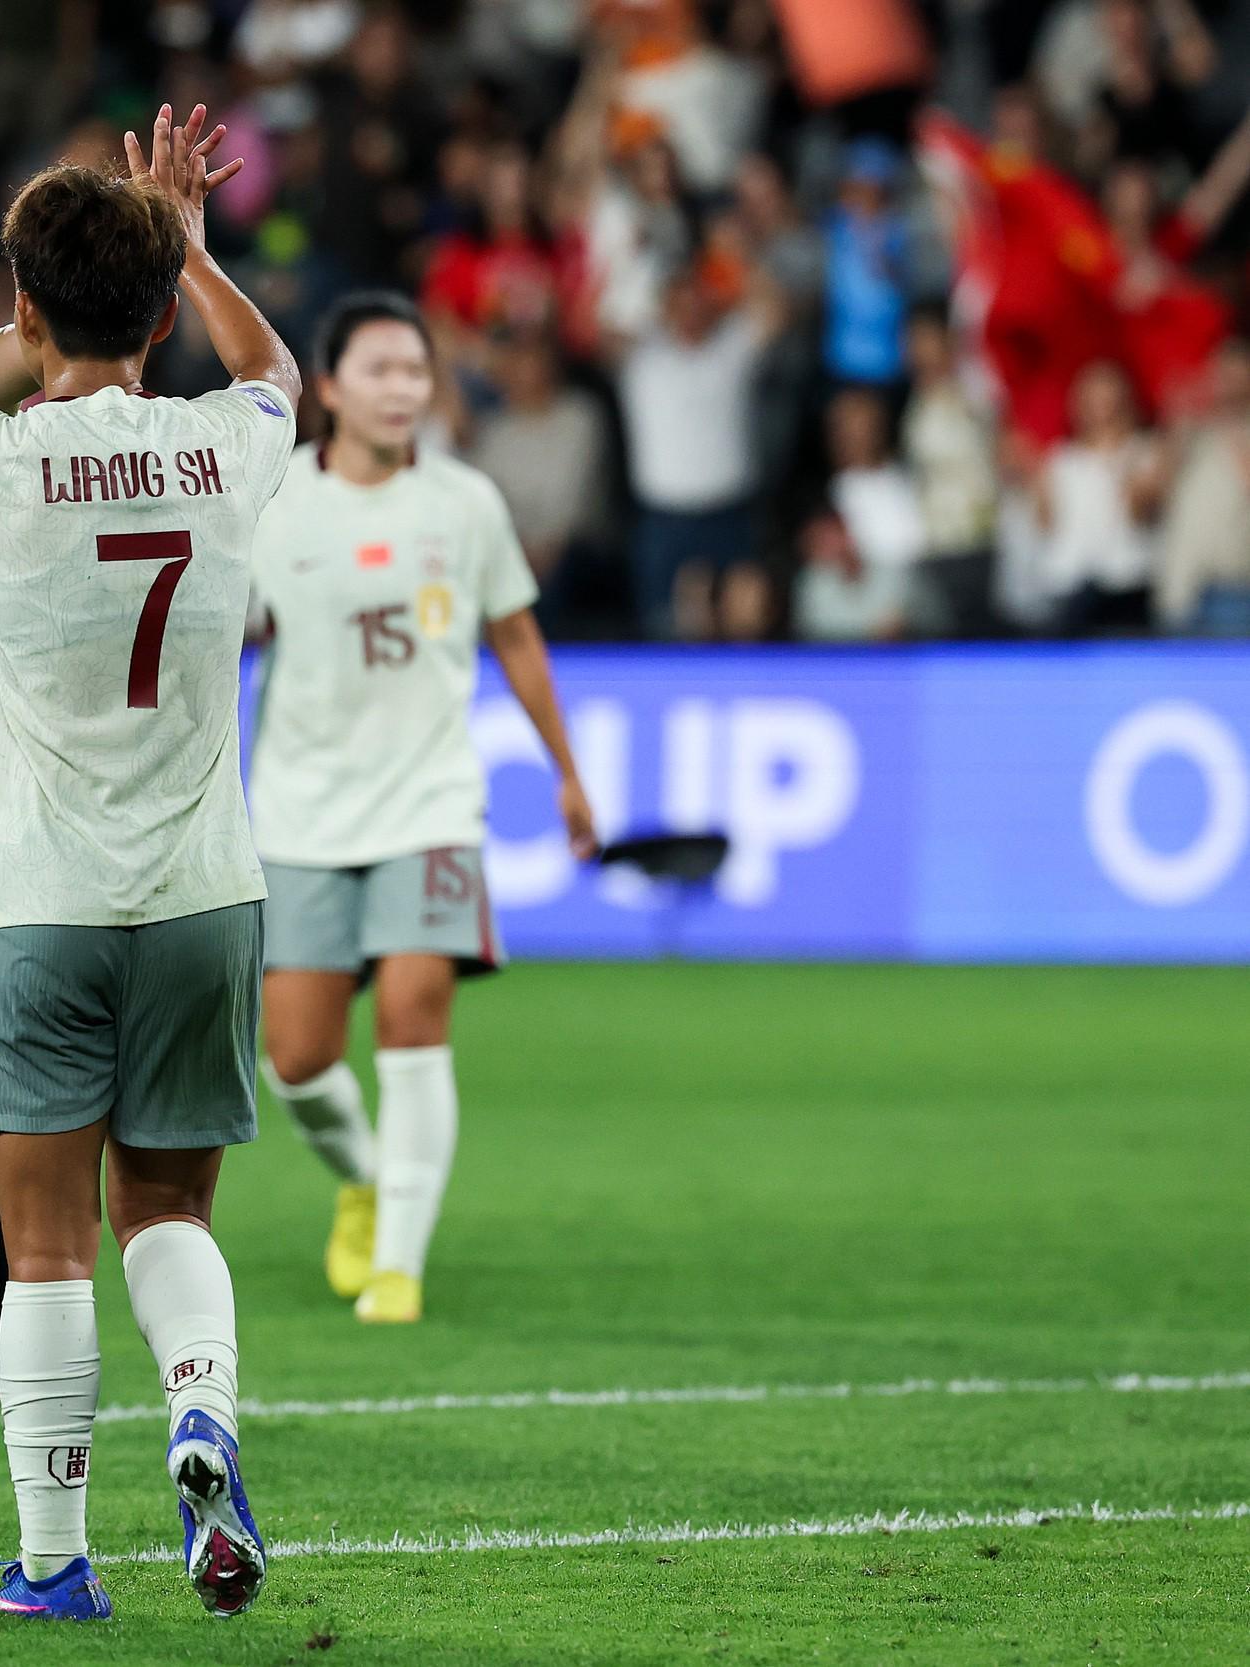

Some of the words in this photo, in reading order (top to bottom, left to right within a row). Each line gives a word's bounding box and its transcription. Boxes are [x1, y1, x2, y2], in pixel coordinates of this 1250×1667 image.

[41, 450, 165, 504] WANG
[95, 529, 193, 709] 7
[352, 604, 416, 669] 15
[1084, 702, 1250, 906] O
[422, 846, 472, 900] 15
